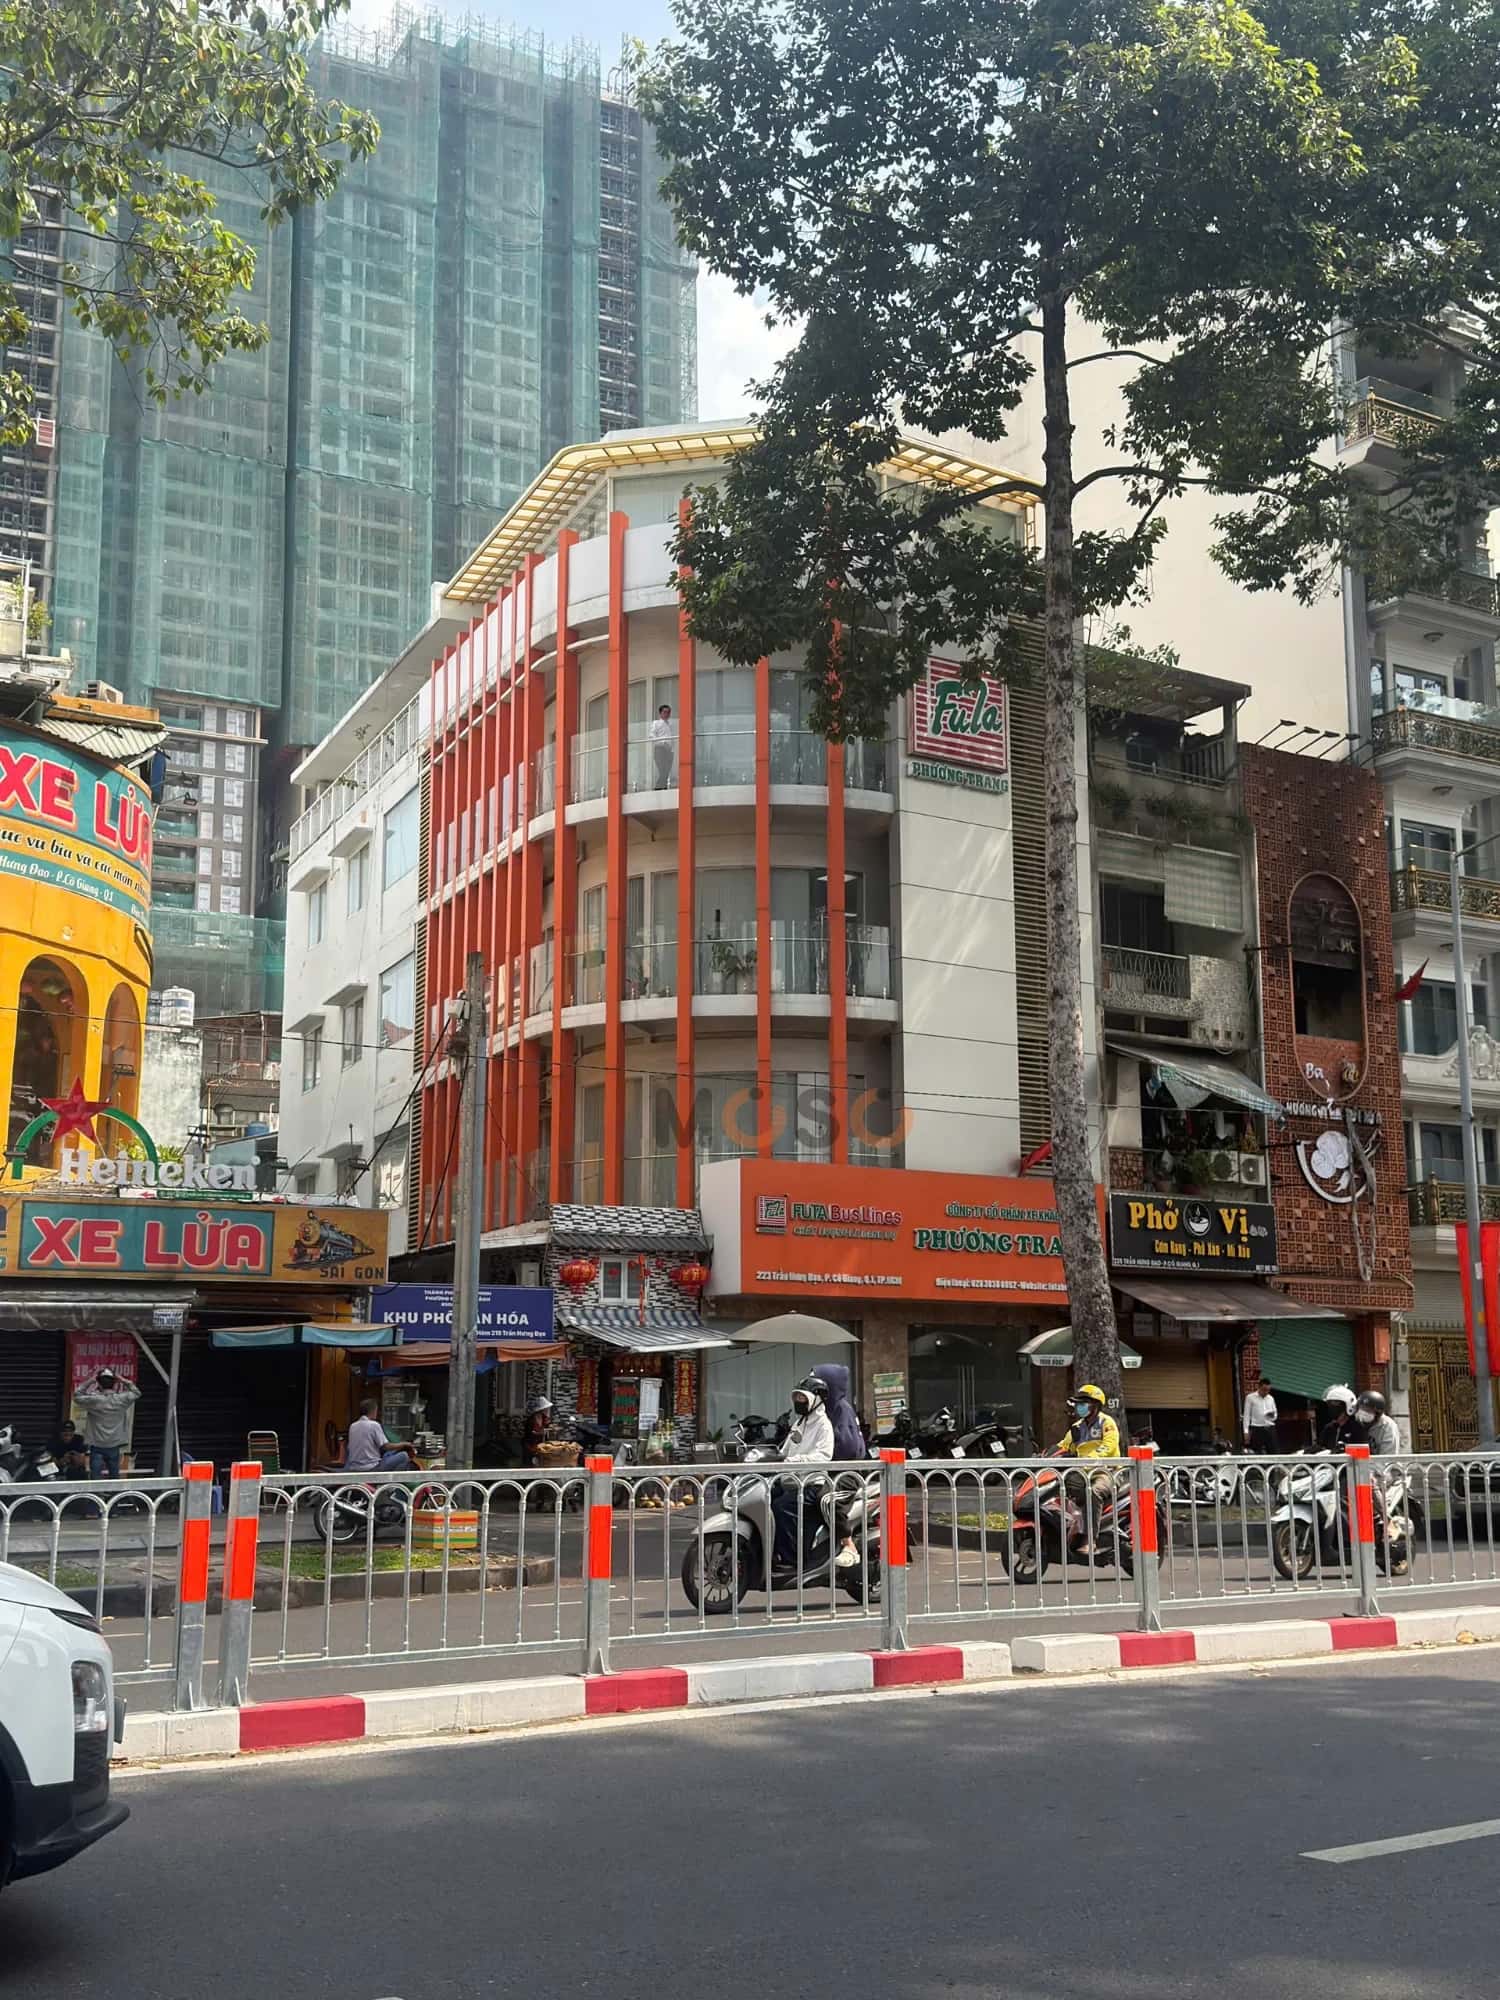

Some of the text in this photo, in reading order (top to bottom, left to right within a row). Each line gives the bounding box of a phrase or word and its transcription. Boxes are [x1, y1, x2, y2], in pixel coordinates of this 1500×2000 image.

[0, 746, 78, 828] XE
[912, 761, 1009, 793] PHƯƠNG TRANG
[60, 1147, 259, 1190] Heineken
[792, 1202, 828, 1221] FUTA
[1127, 1200, 1179, 1231] Phở
[1218, 1208, 1248, 1243] Vị
[28, 1210, 267, 1272] XE LỬA
[915, 1226, 1013, 1256] PHƯƠNG
[383, 1311, 418, 1325] KHU
[496, 1311, 529, 1326] HÓA
